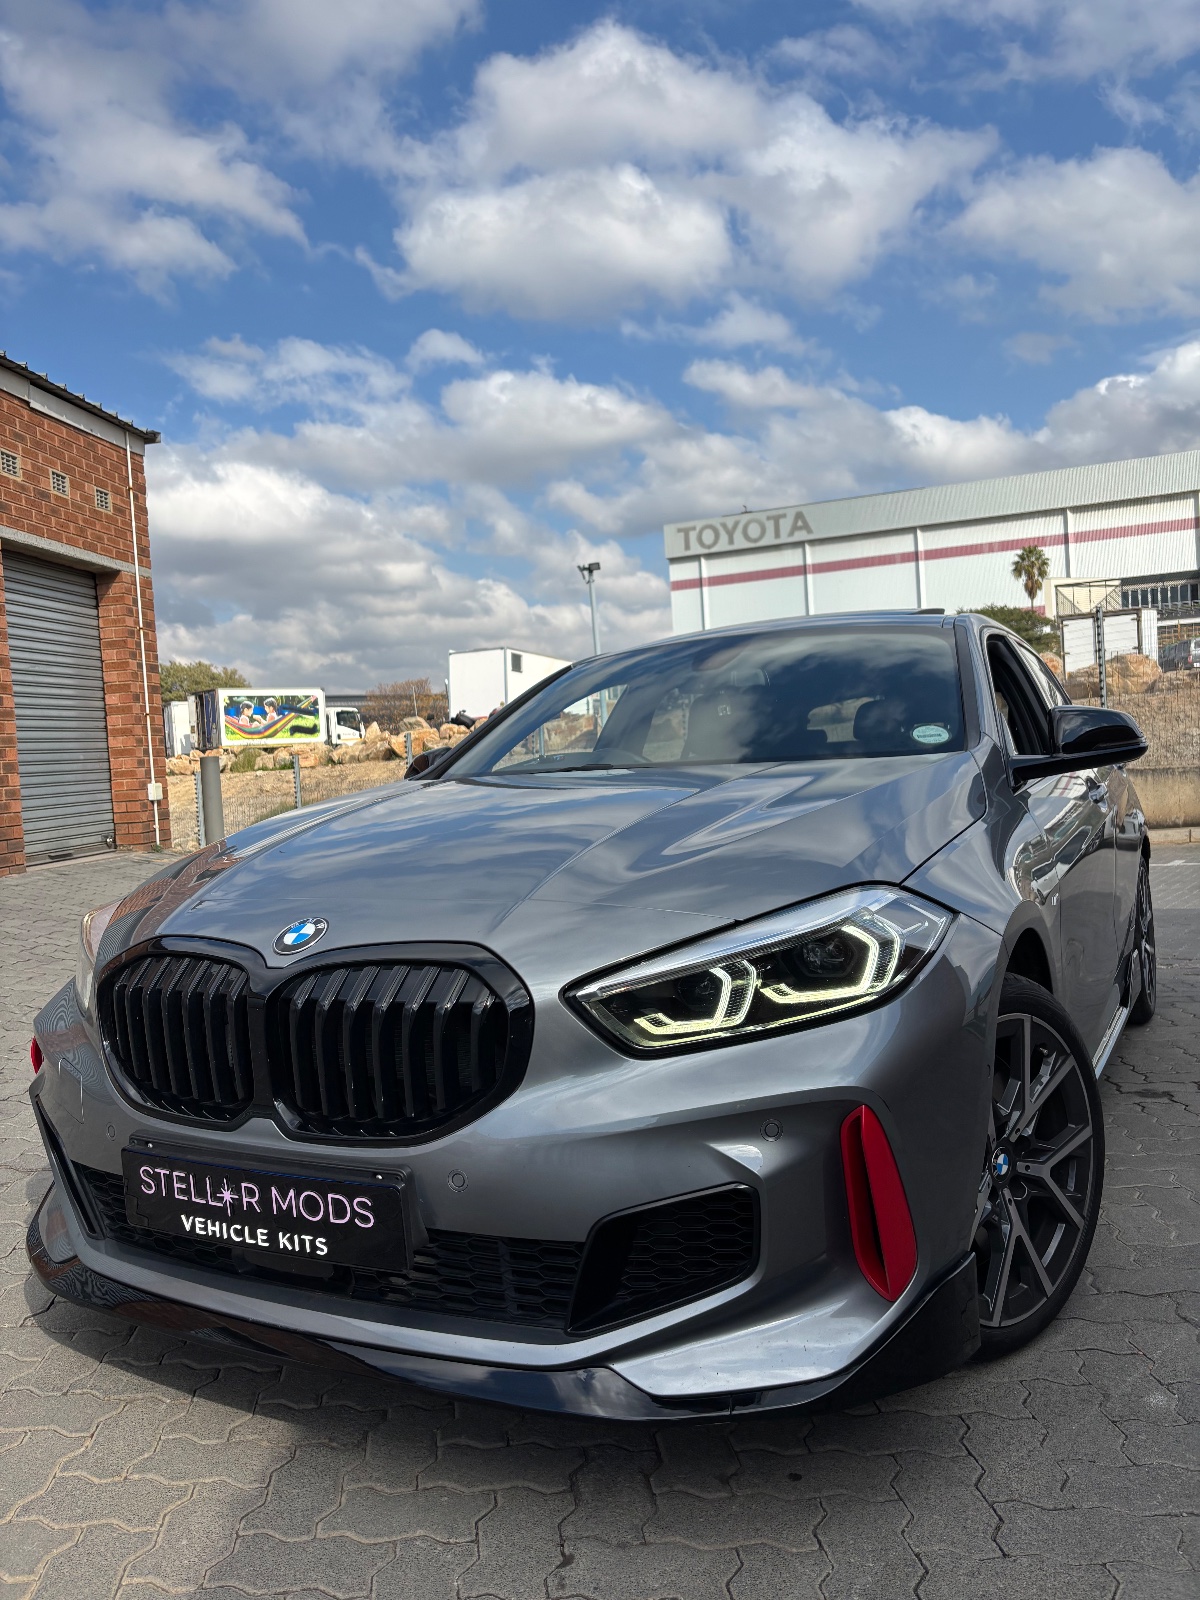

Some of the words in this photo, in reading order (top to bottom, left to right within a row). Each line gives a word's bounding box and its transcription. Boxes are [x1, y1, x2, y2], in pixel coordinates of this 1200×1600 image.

[677, 511, 814, 551] TOYOTA
[271, 1186, 375, 1228] MODS
[180, 1214, 270, 1247] VEHICLE
[278, 1231, 328, 1256] KITS
